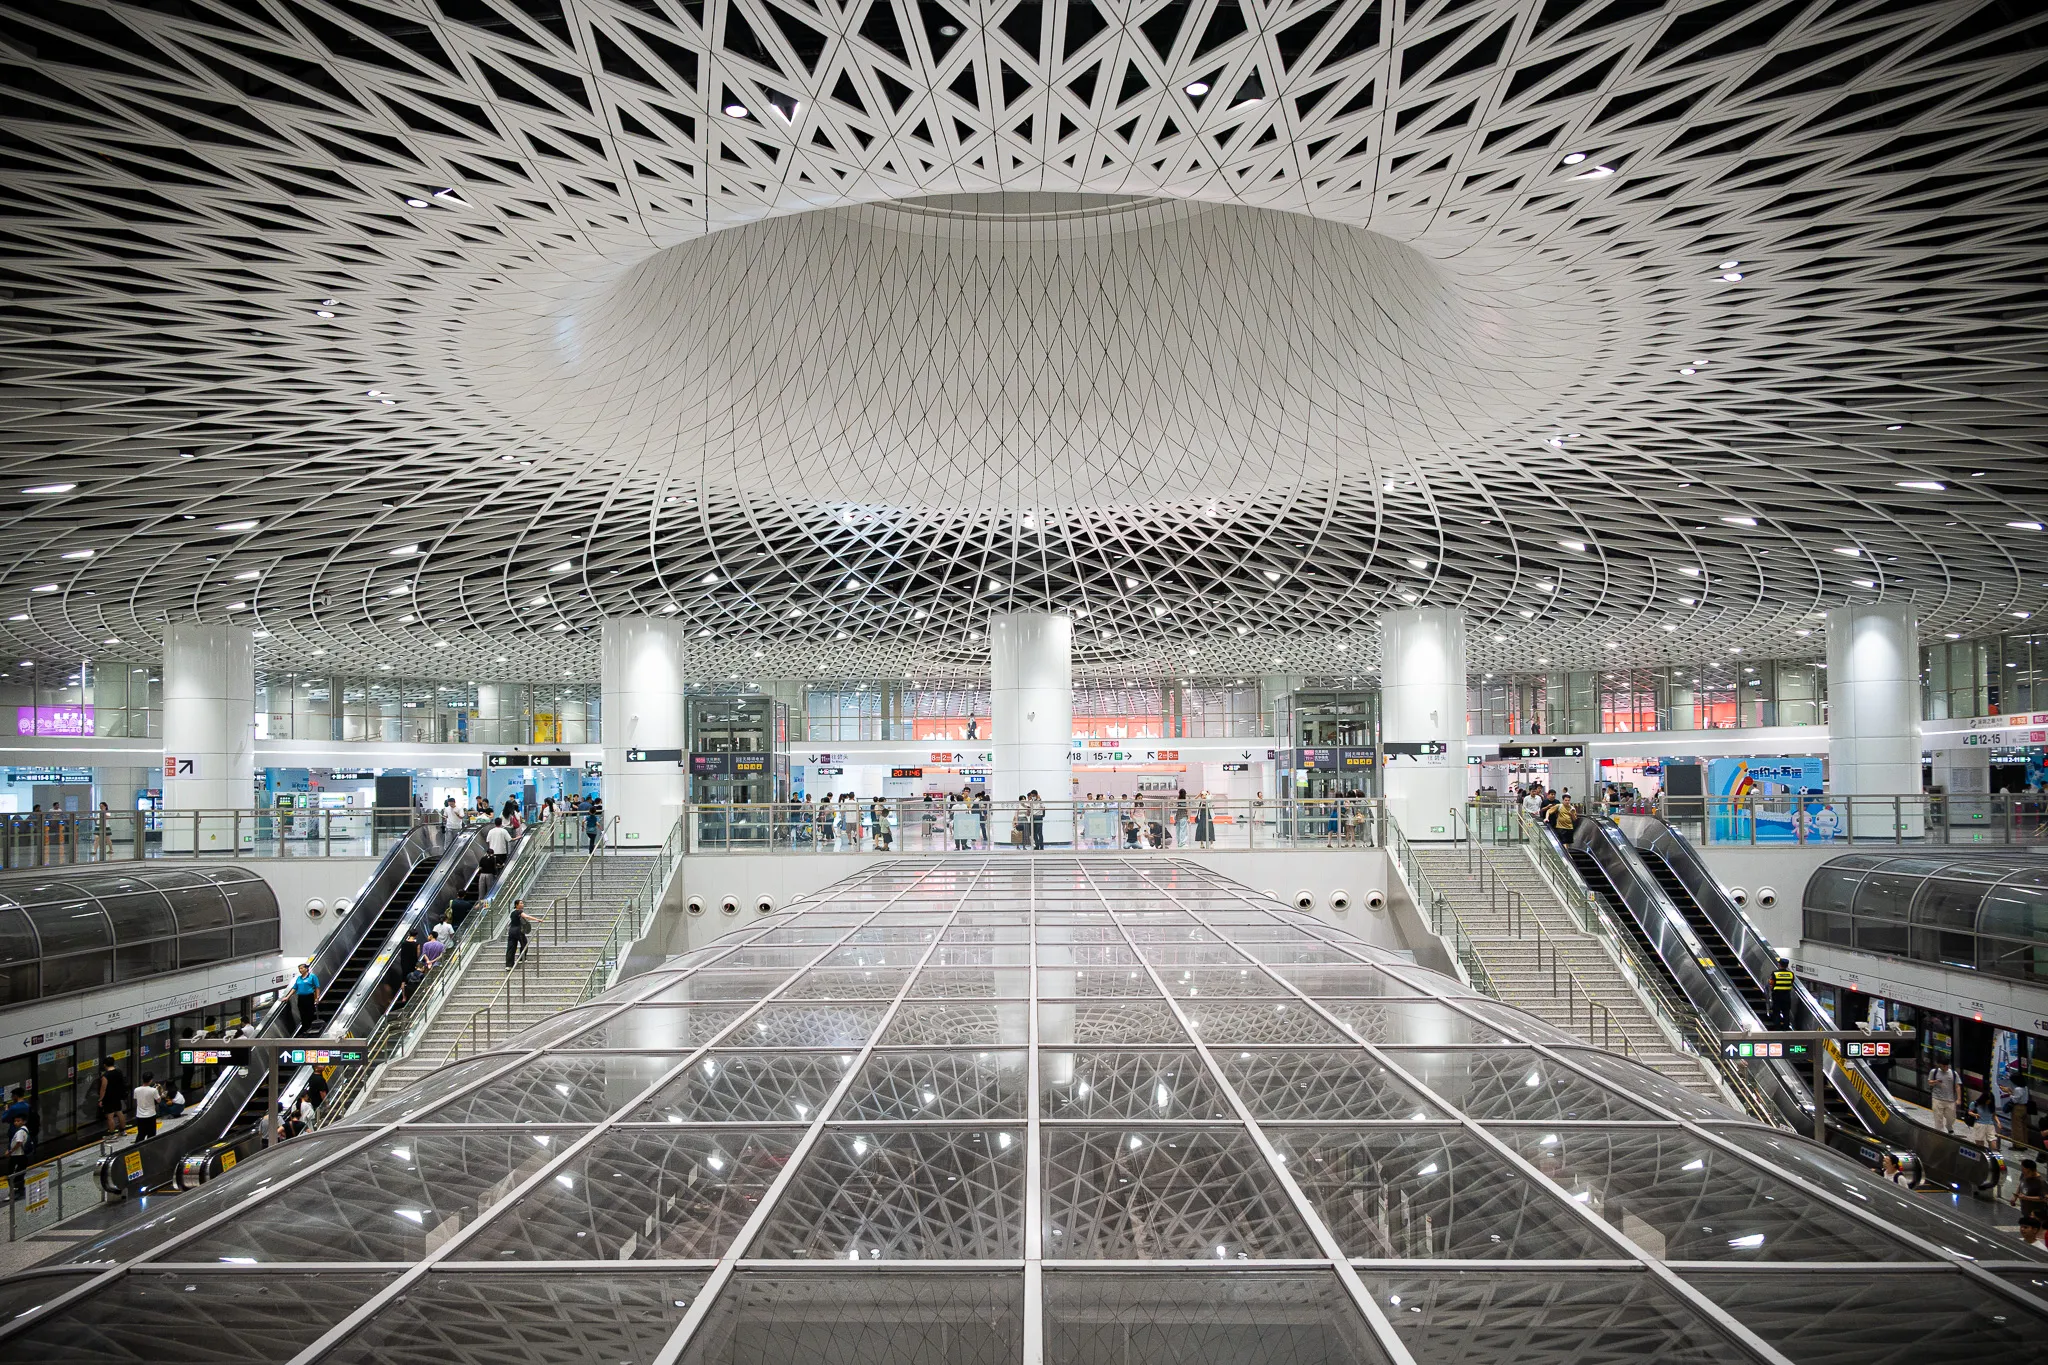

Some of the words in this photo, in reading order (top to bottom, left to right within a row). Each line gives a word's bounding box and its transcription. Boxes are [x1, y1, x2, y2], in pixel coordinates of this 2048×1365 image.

[1979, 733, 2000, 745] 12-15
[1073, 752, 1081, 760] 18
[1093, 752, 1113, 760] 15-7
[1748, 766, 1802, 779] 相约十五运
